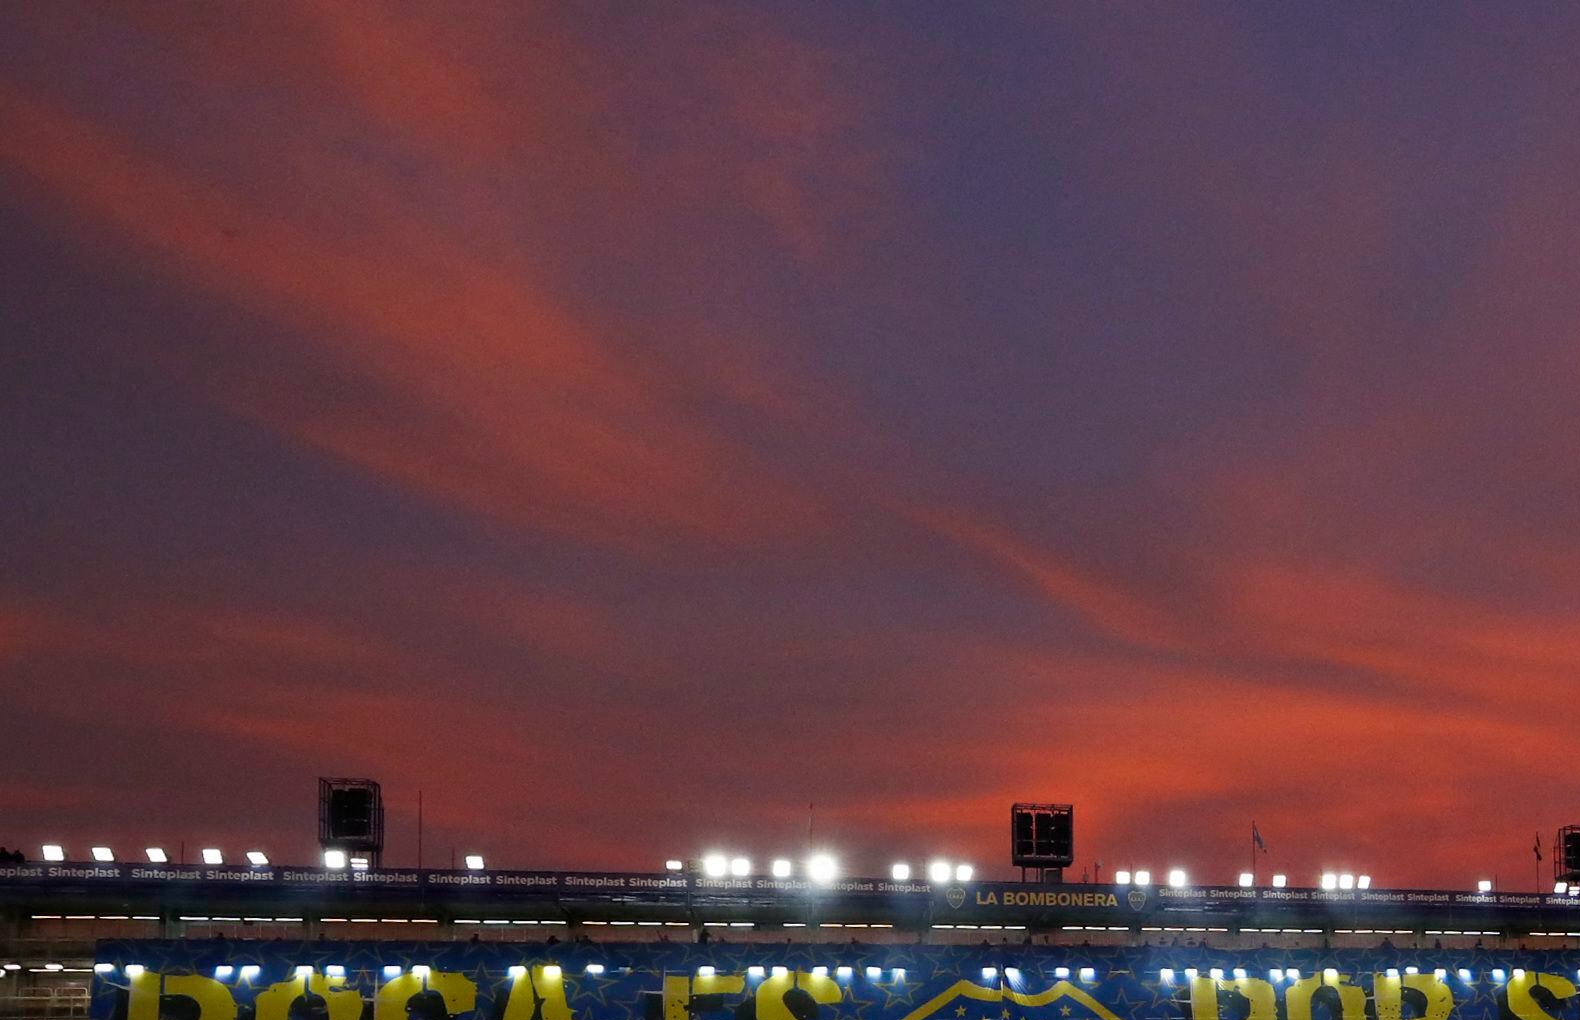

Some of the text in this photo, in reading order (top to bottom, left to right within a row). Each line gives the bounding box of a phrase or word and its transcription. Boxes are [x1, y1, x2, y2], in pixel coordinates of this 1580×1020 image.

[48, 867, 120, 880] Sinteplast
[131, 868, 201, 881] Sinteplast
[206, 869, 274, 882] Sinteplast
[283, 870, 348, 883] Sinteplast
[353, 871, 418, 884] Sinteplast
[428, 873, 491, 886] Sinteplast
[496, 874, 557, 887] Sinteplast
[565, 875, 625, 888] Sinteplast
[629, 876, 688, 889] Sinteplast
[695, 878, 753, 890] Sinteplast
[878, 881, 931, 893] Sinteplast
[976, 892, 998, 905] LA
[1003, 891, 1118, 907] BOMBONERA
[1159, 887, 1207, 900] Sinteplast
[1210, 888, 1257, 901] Sinteplast
[1262, 889, 1308, 901] Sinteplast
[1311, 891, 1356, 902] Sinteplast
[1361, 892, 1405, 904] Sinteplast
[1407, 893, 1449, 905] Sinteplast
[1455, 894, 1498, 905] Sinteplast
[1499, 895, 1540, 906] Sinteplast
